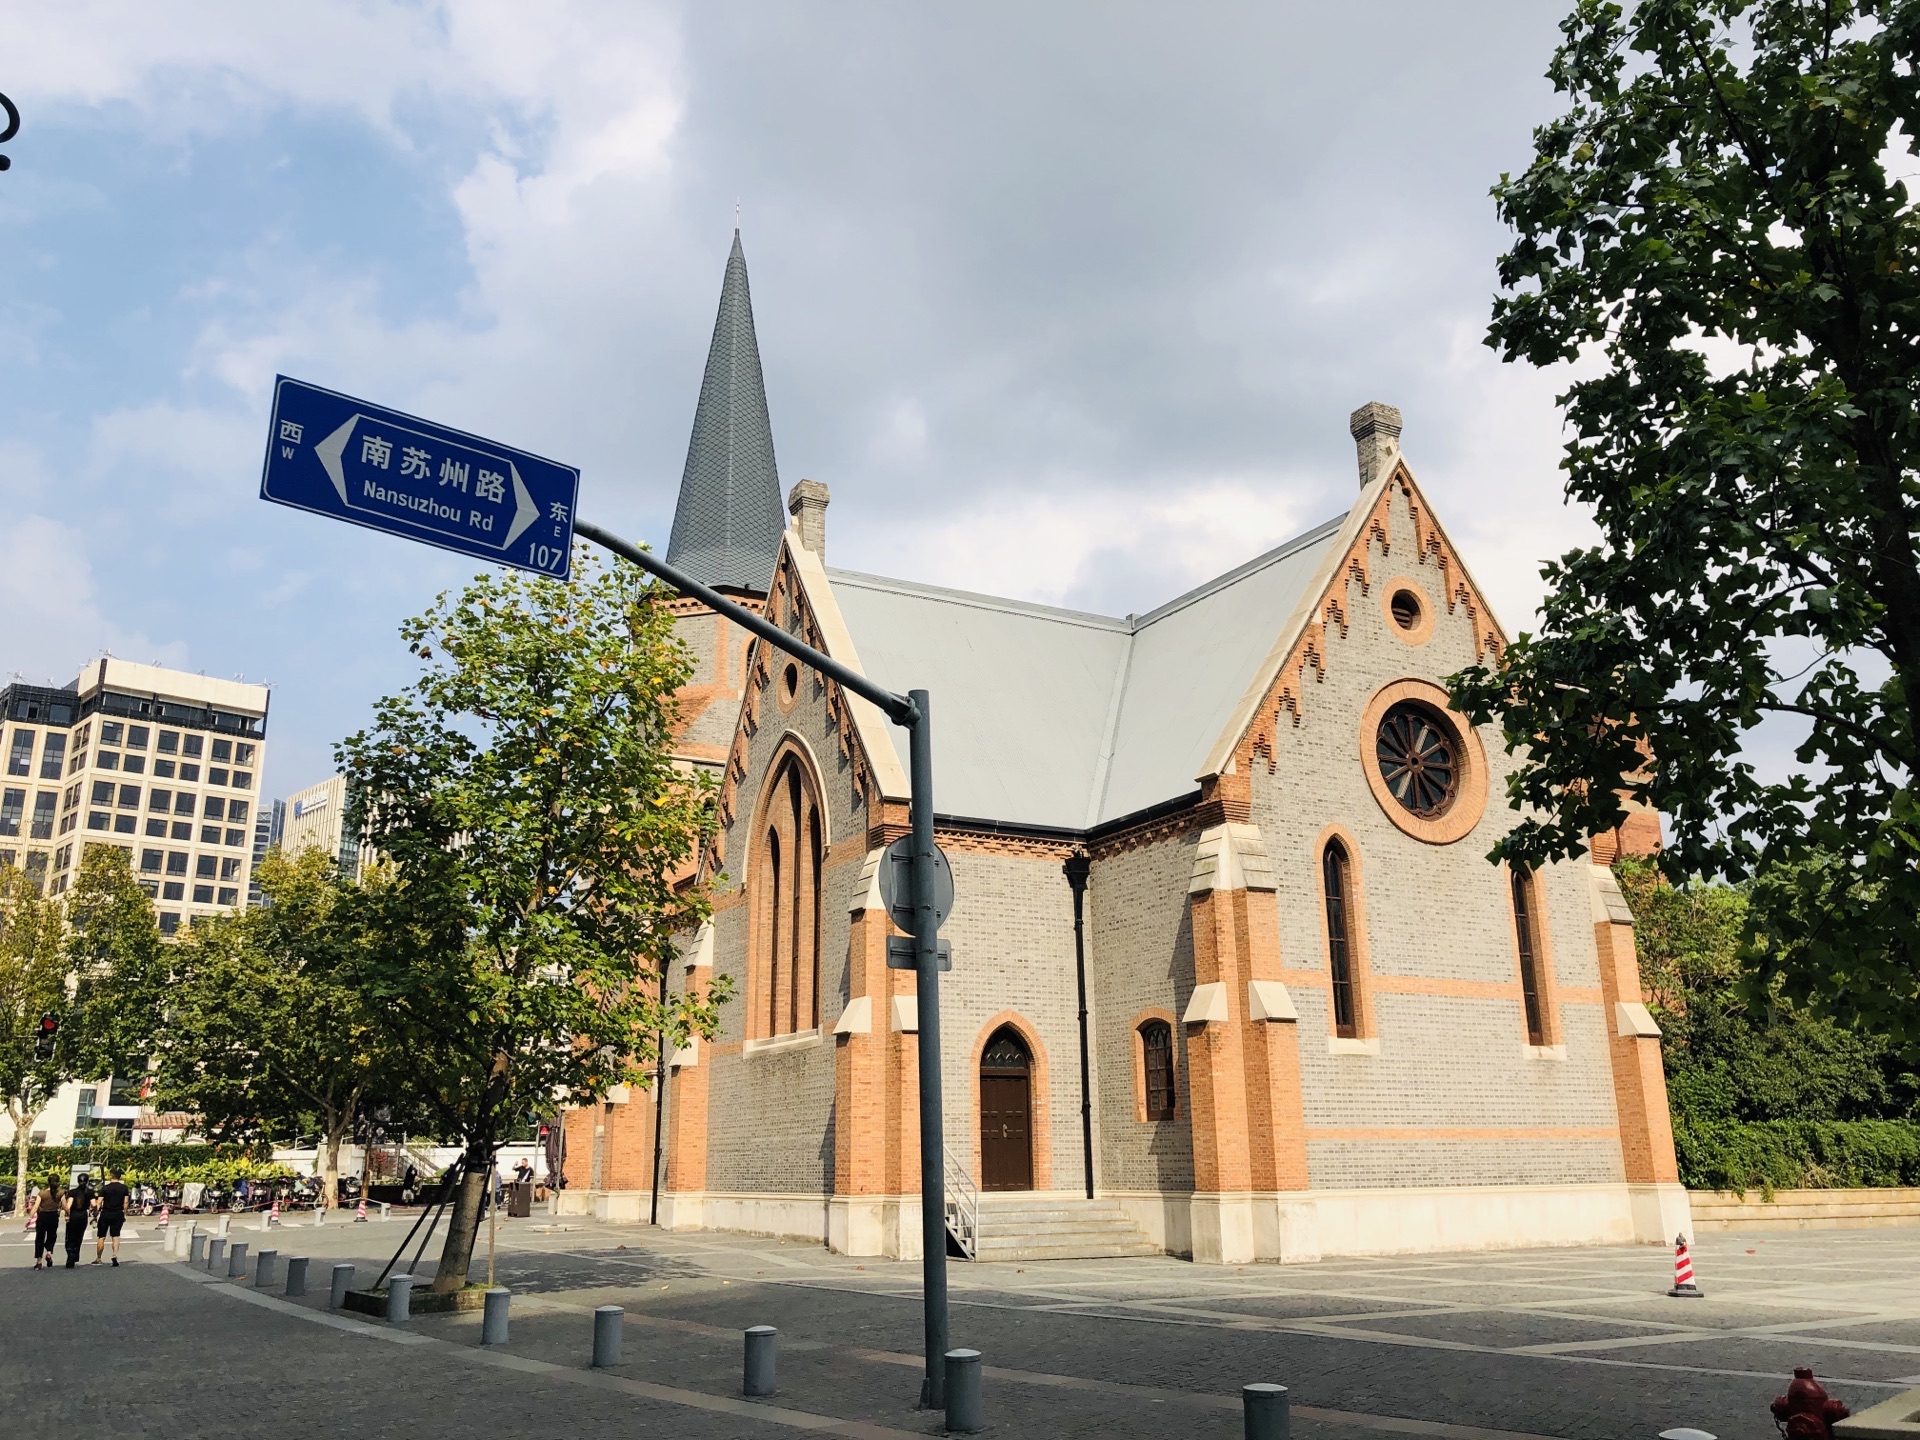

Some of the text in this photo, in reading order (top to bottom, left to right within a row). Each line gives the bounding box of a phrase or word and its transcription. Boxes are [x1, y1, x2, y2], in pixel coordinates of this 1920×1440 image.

[280, 419, 304, 444] 西
[282, 445, 294, 460] W
[361, 435, 506, 503] 南苏州路
[363, 479, 493, 532] Nansuzhou Rd
[549, 501, 569, 524] 东
[554, 526, 561, 538] E
[528, 542, 562, 571] 107
